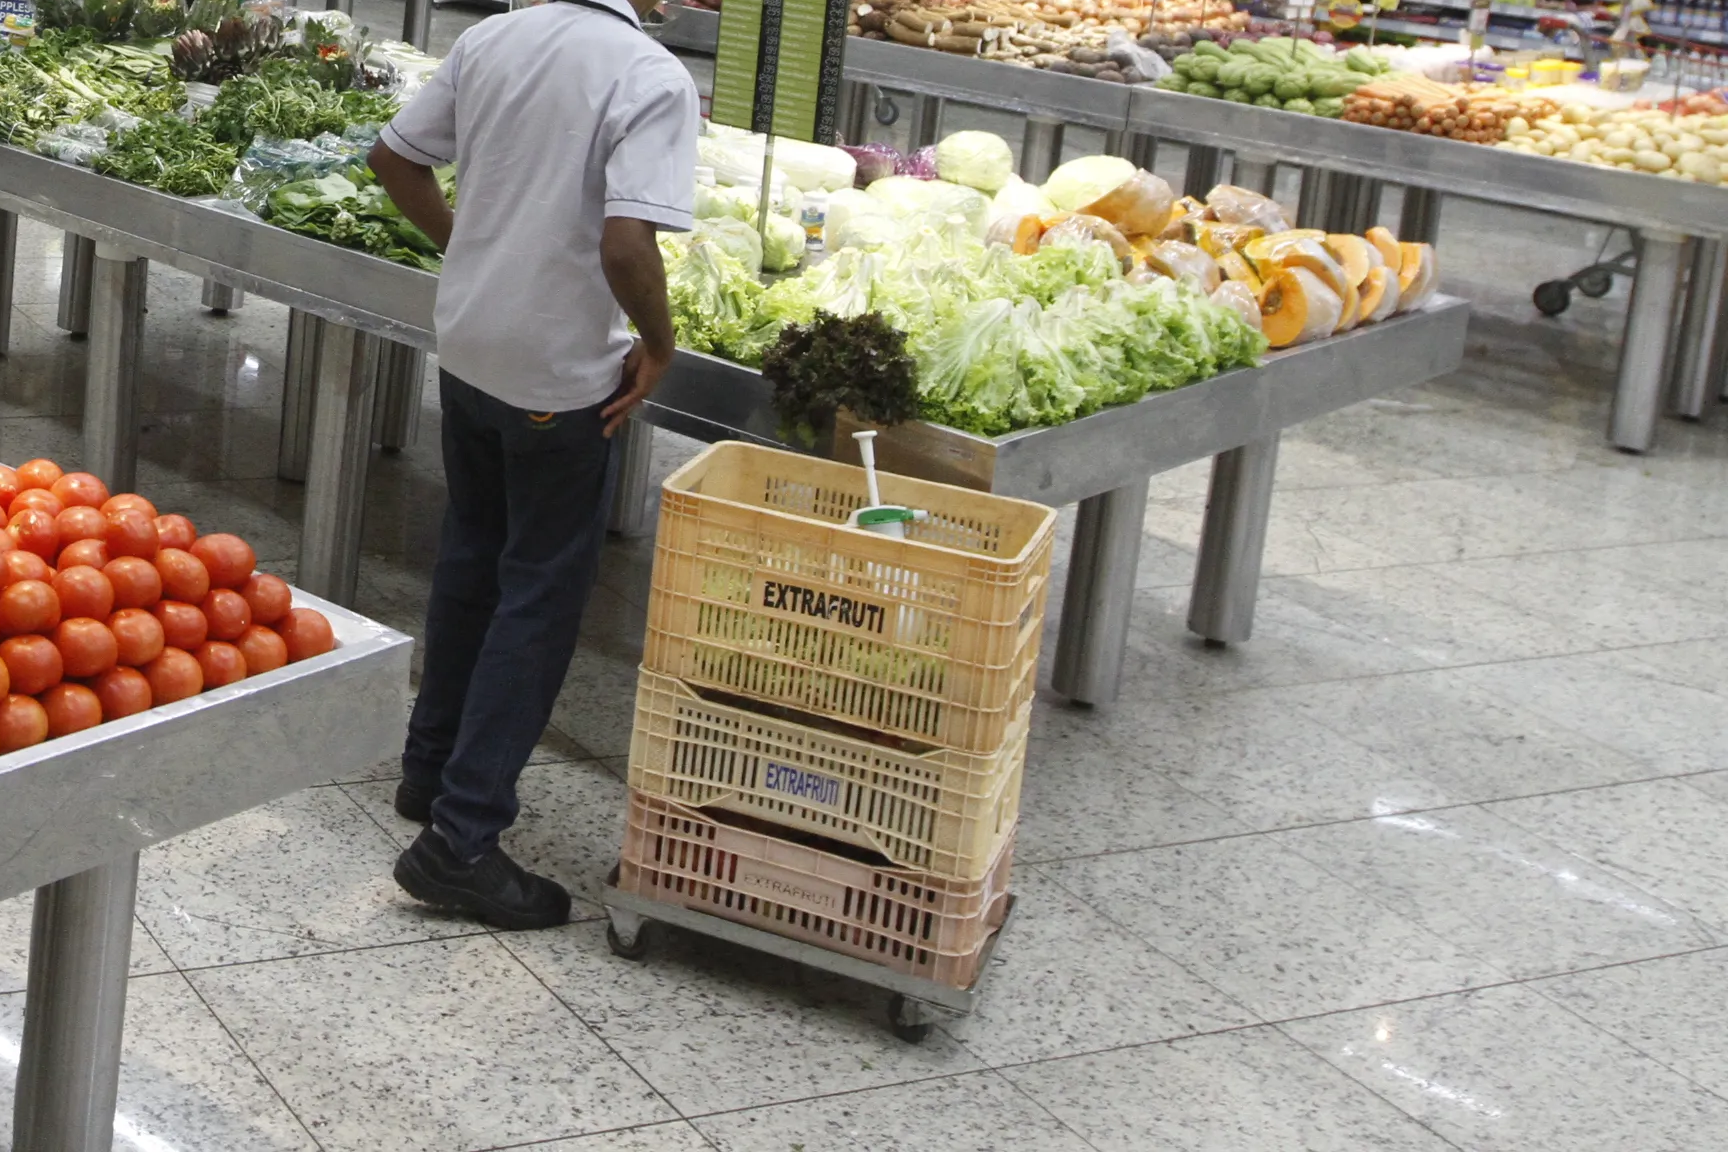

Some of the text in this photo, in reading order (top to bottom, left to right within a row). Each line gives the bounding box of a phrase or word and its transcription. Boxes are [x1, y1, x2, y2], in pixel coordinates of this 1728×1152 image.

[763, 580, 885, 634] EXTRAFRUTI
[765, 763, 840, 806] EXTRAFRUTI
[743, 873, 836, 909] EXTRAFRUTI
